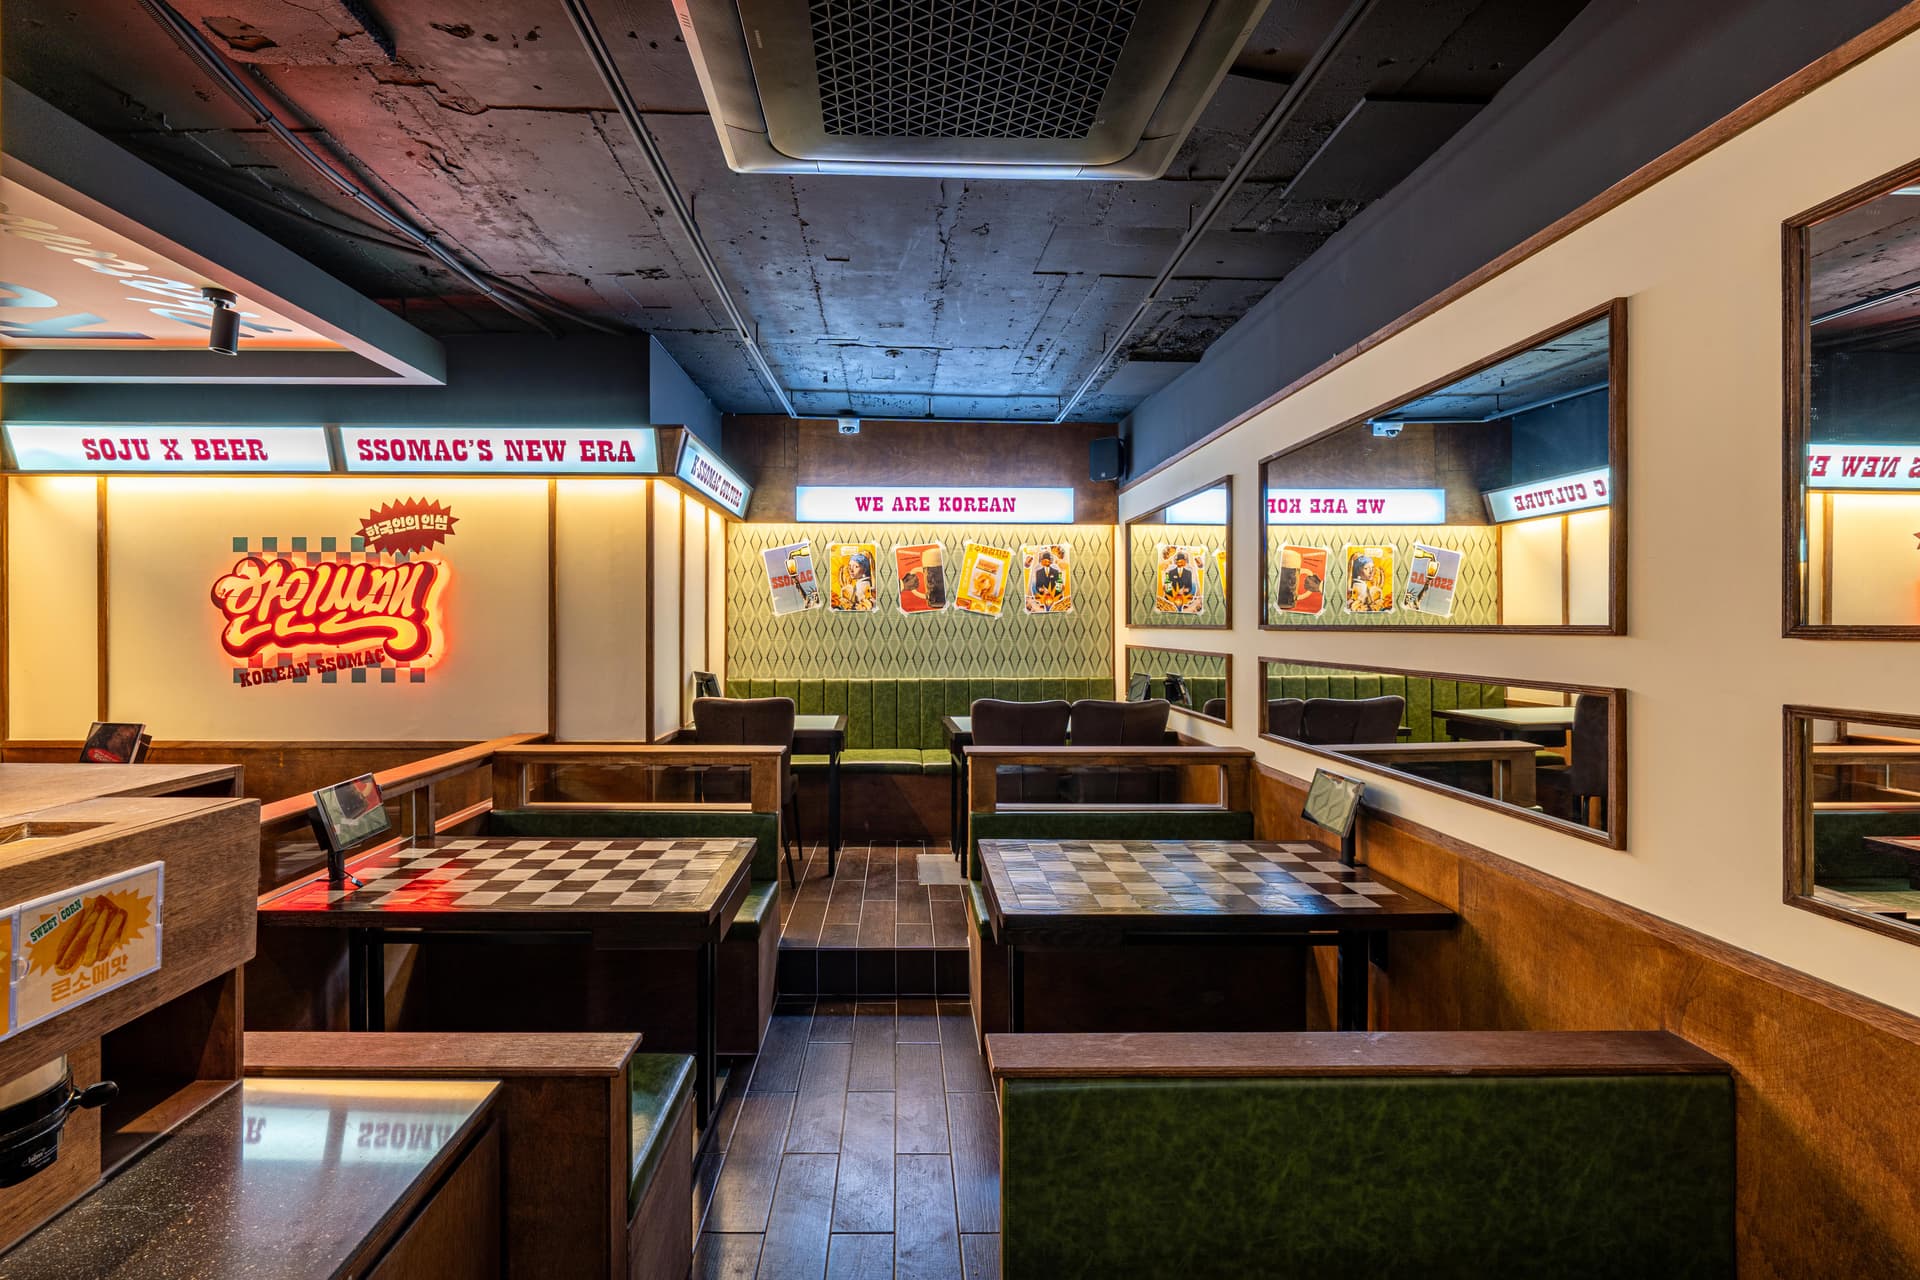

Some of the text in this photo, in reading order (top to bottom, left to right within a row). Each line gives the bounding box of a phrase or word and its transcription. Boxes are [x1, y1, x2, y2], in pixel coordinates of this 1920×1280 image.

[81, 438, 268, 461] SOJU X BEER
[503, 439, 567, 462] NEW
[579, 440, 636, 463] ERA
[719, 479, 743, 508] CULTURE
[855, 496, 1017, 513] WE ARE KOREAN
[365, 513, 449, 542] 한국인의 인심
[239, 647, 386, 688] KOREAN SSOMAC
[29, 898, 83, 943] SWEET CORN
[51, 953, 129, 1003] 콘소메맛
